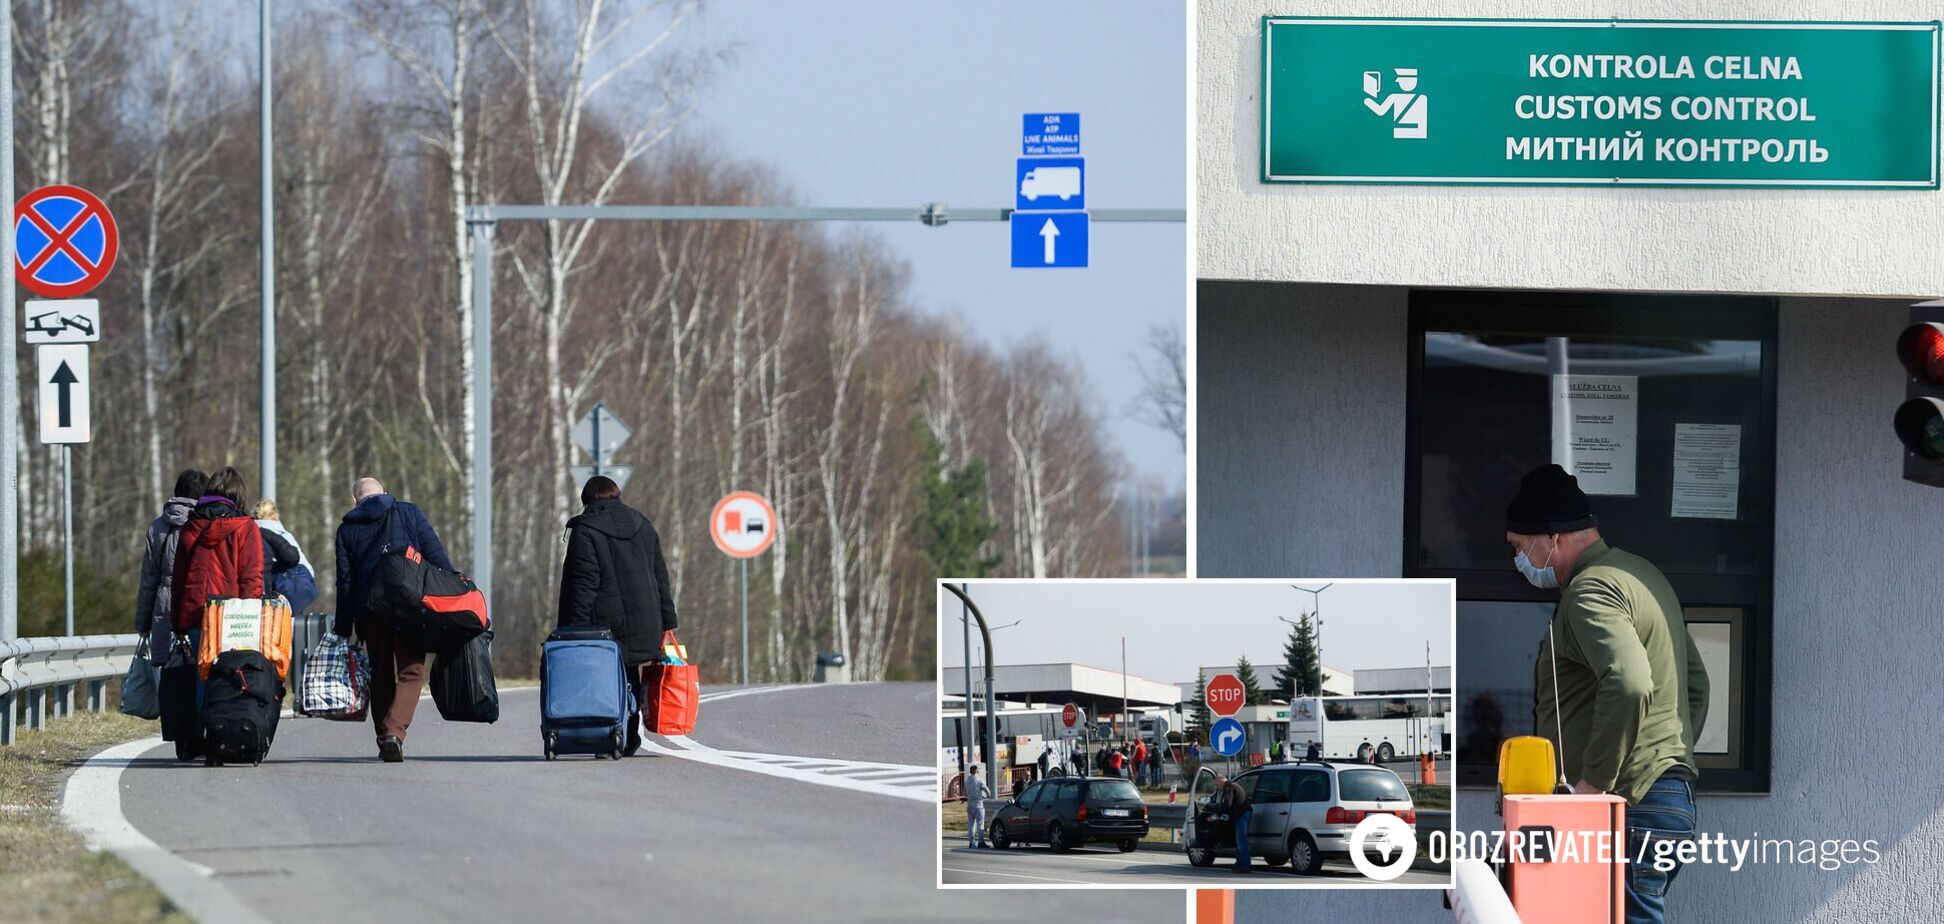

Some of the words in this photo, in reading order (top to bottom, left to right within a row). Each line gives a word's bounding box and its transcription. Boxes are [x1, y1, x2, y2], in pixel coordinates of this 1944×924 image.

[1529, 54, 1696, 79] KONTROLA
[1704, 55, 1803, 80] CELNA
[1515, 95, 1662, 120] CUSTOMS
[1670, 96, 1816, 121] CONTROL
[1043, 115, 1061, 124] ADR
[1044, 124, 1060, 133] ATP
[1024, 135, 1041, 144] LIVE
[1042, 134, 1079, 143] ANIMALS
[1506, 130, 1644, 161] МИТНИЙ
[1655, 138, 1829, 163] КОНТРОЛЬ
[1210, 687, 1241, 702] STOP
